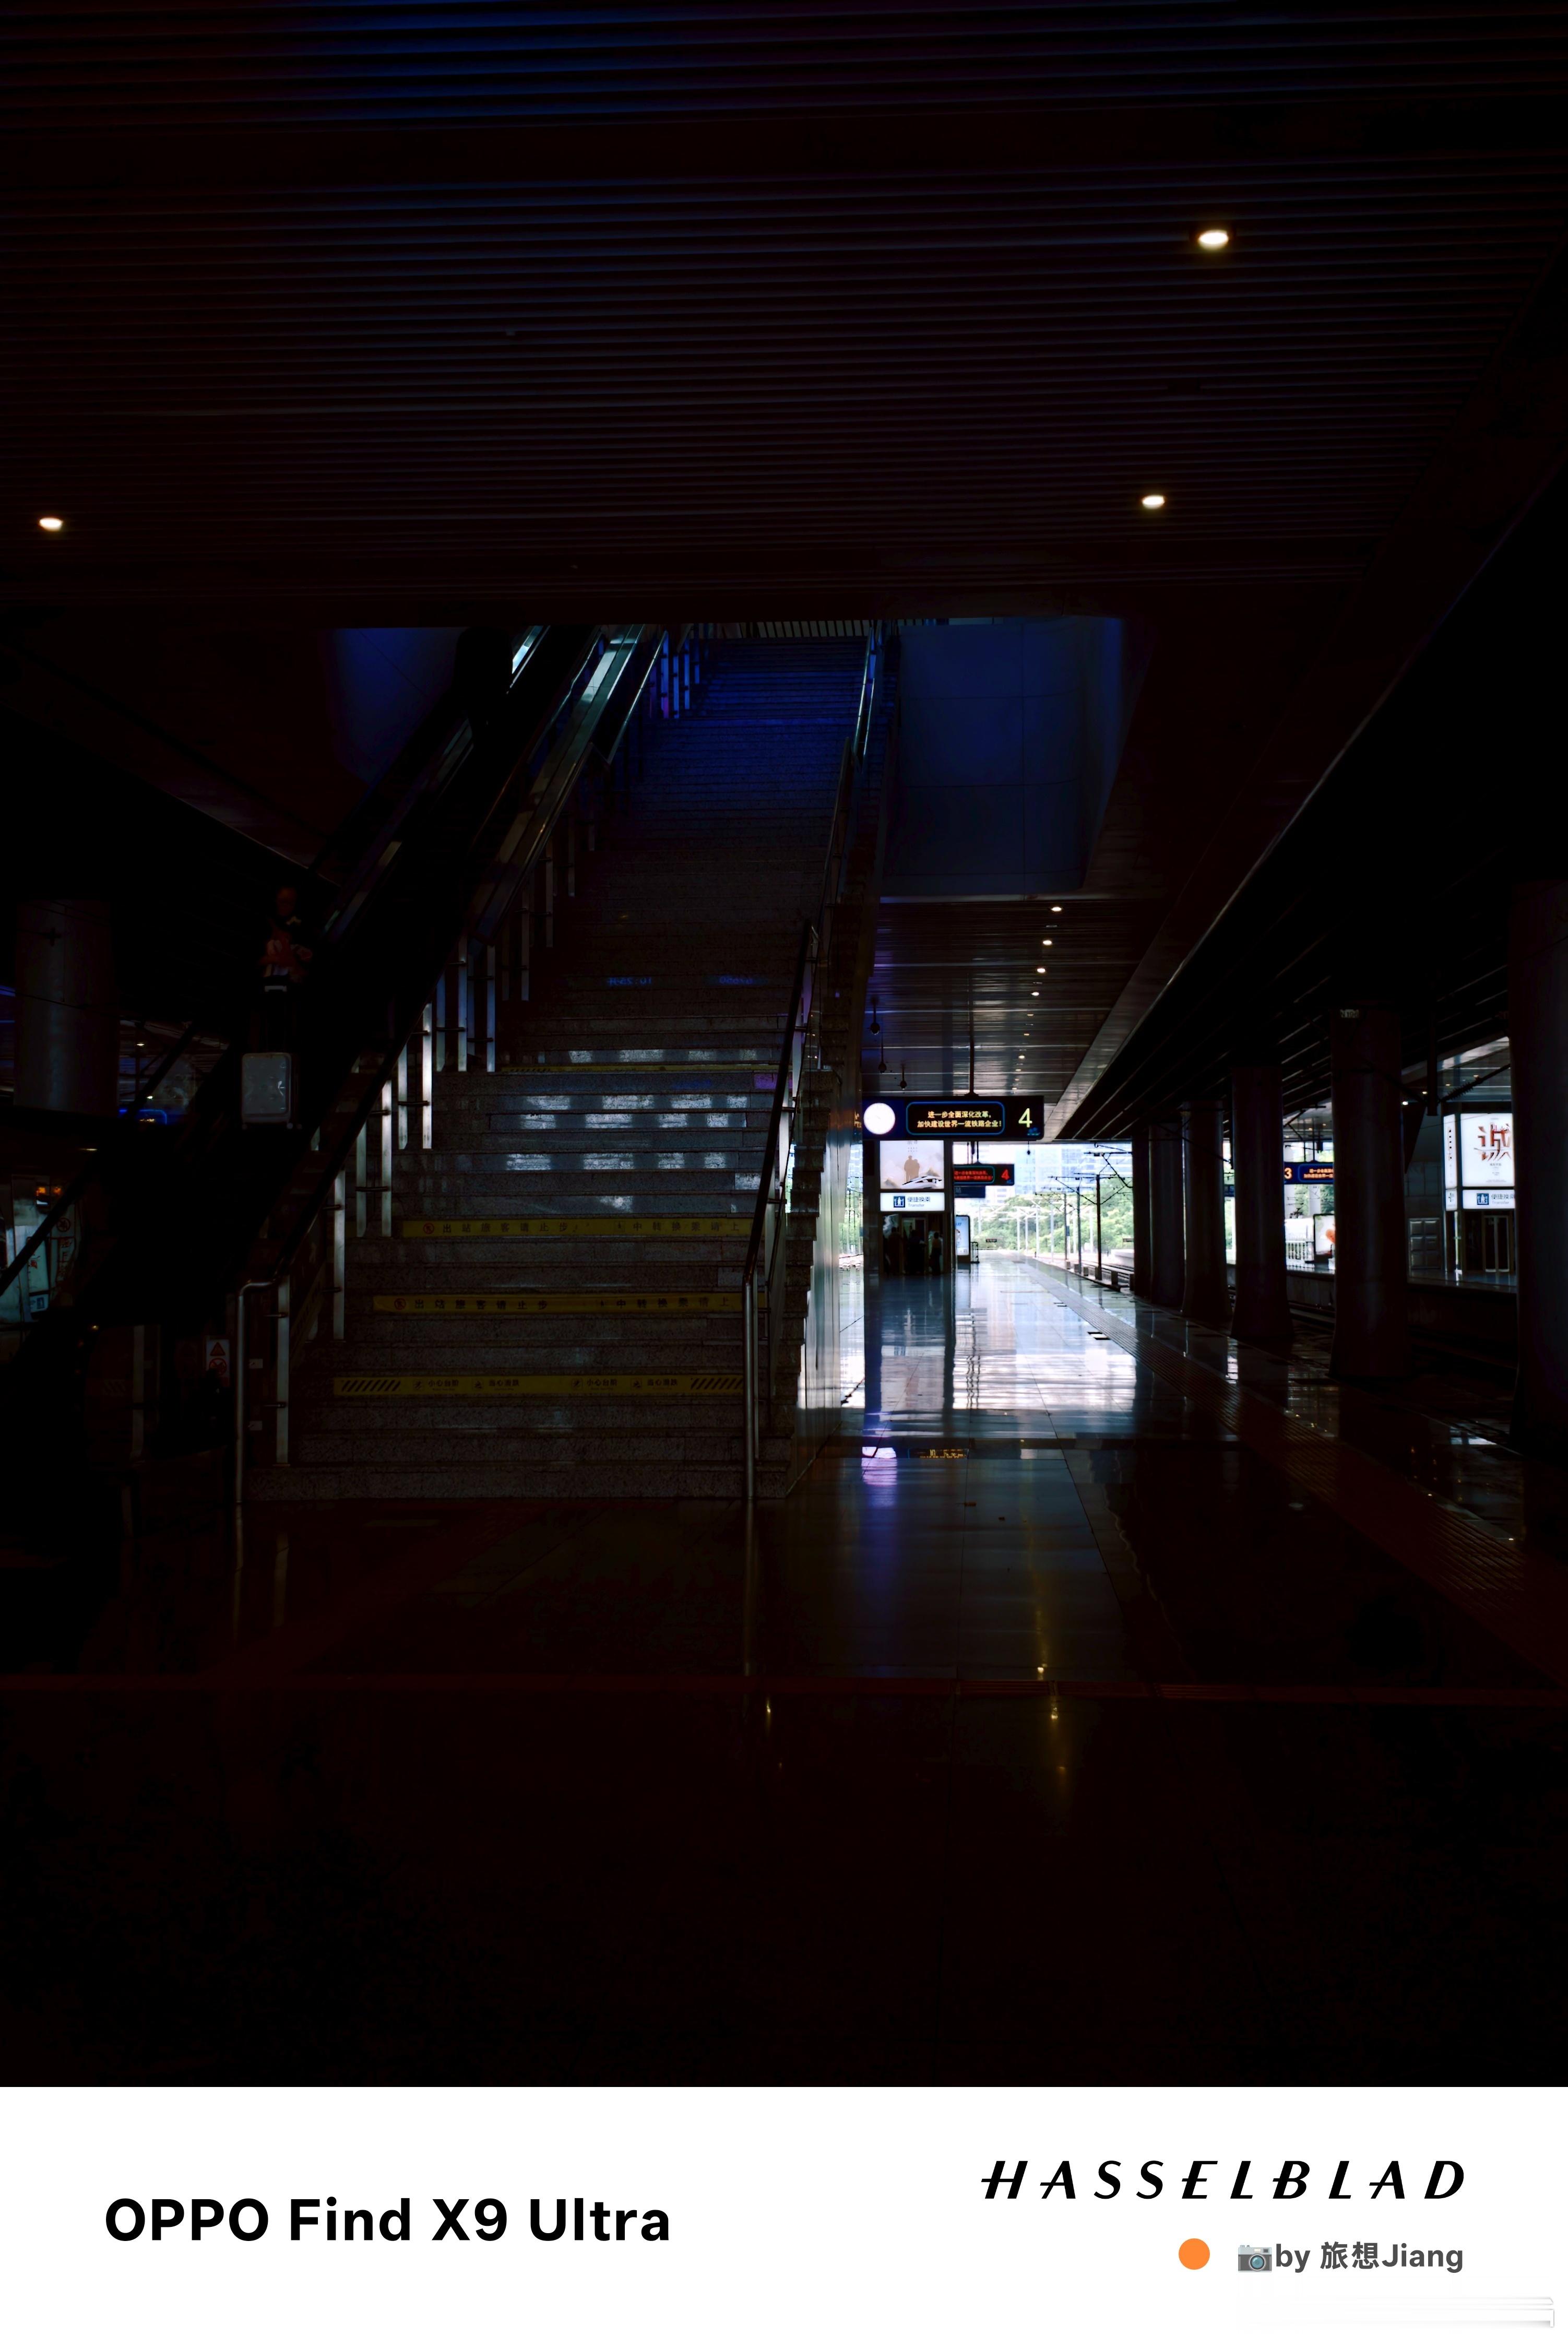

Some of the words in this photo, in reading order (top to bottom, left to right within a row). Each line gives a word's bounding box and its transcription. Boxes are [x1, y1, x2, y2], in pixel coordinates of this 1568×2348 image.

[1018, 1108, 1033, 1128] 4
[1001, 1169, 1009, 1180] 4
[1284, 1167, 1292, 1179] 3
